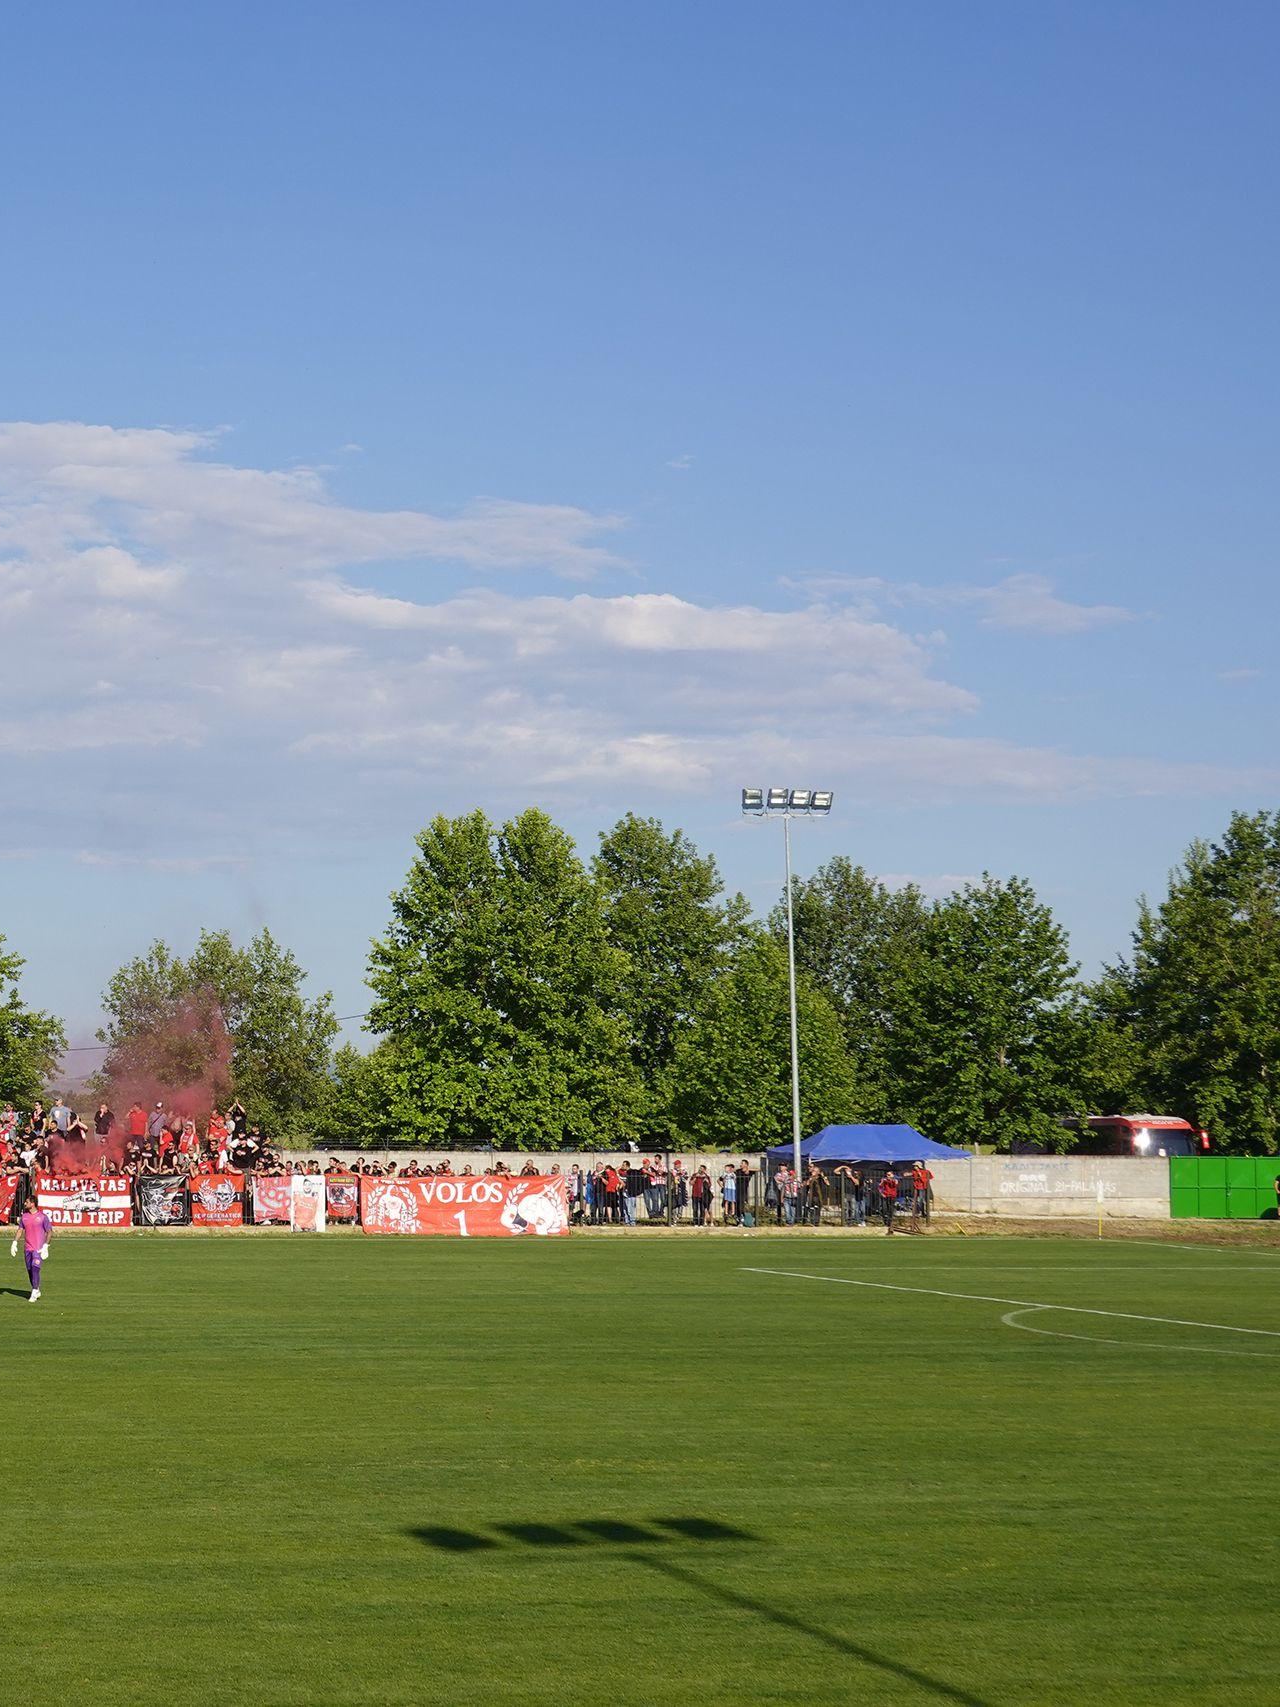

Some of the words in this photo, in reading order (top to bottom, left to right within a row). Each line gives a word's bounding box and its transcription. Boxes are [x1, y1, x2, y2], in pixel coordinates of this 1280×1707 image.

[418, 1181, 504, 1204] VOLOS
[999, 1181, 1052, 1193] ORIGINAL
[42, 1209, 83, 1224] ROAD
[87, 1211, 125, 1224] TRIP
[453, 1209, 471, 1237] 1
